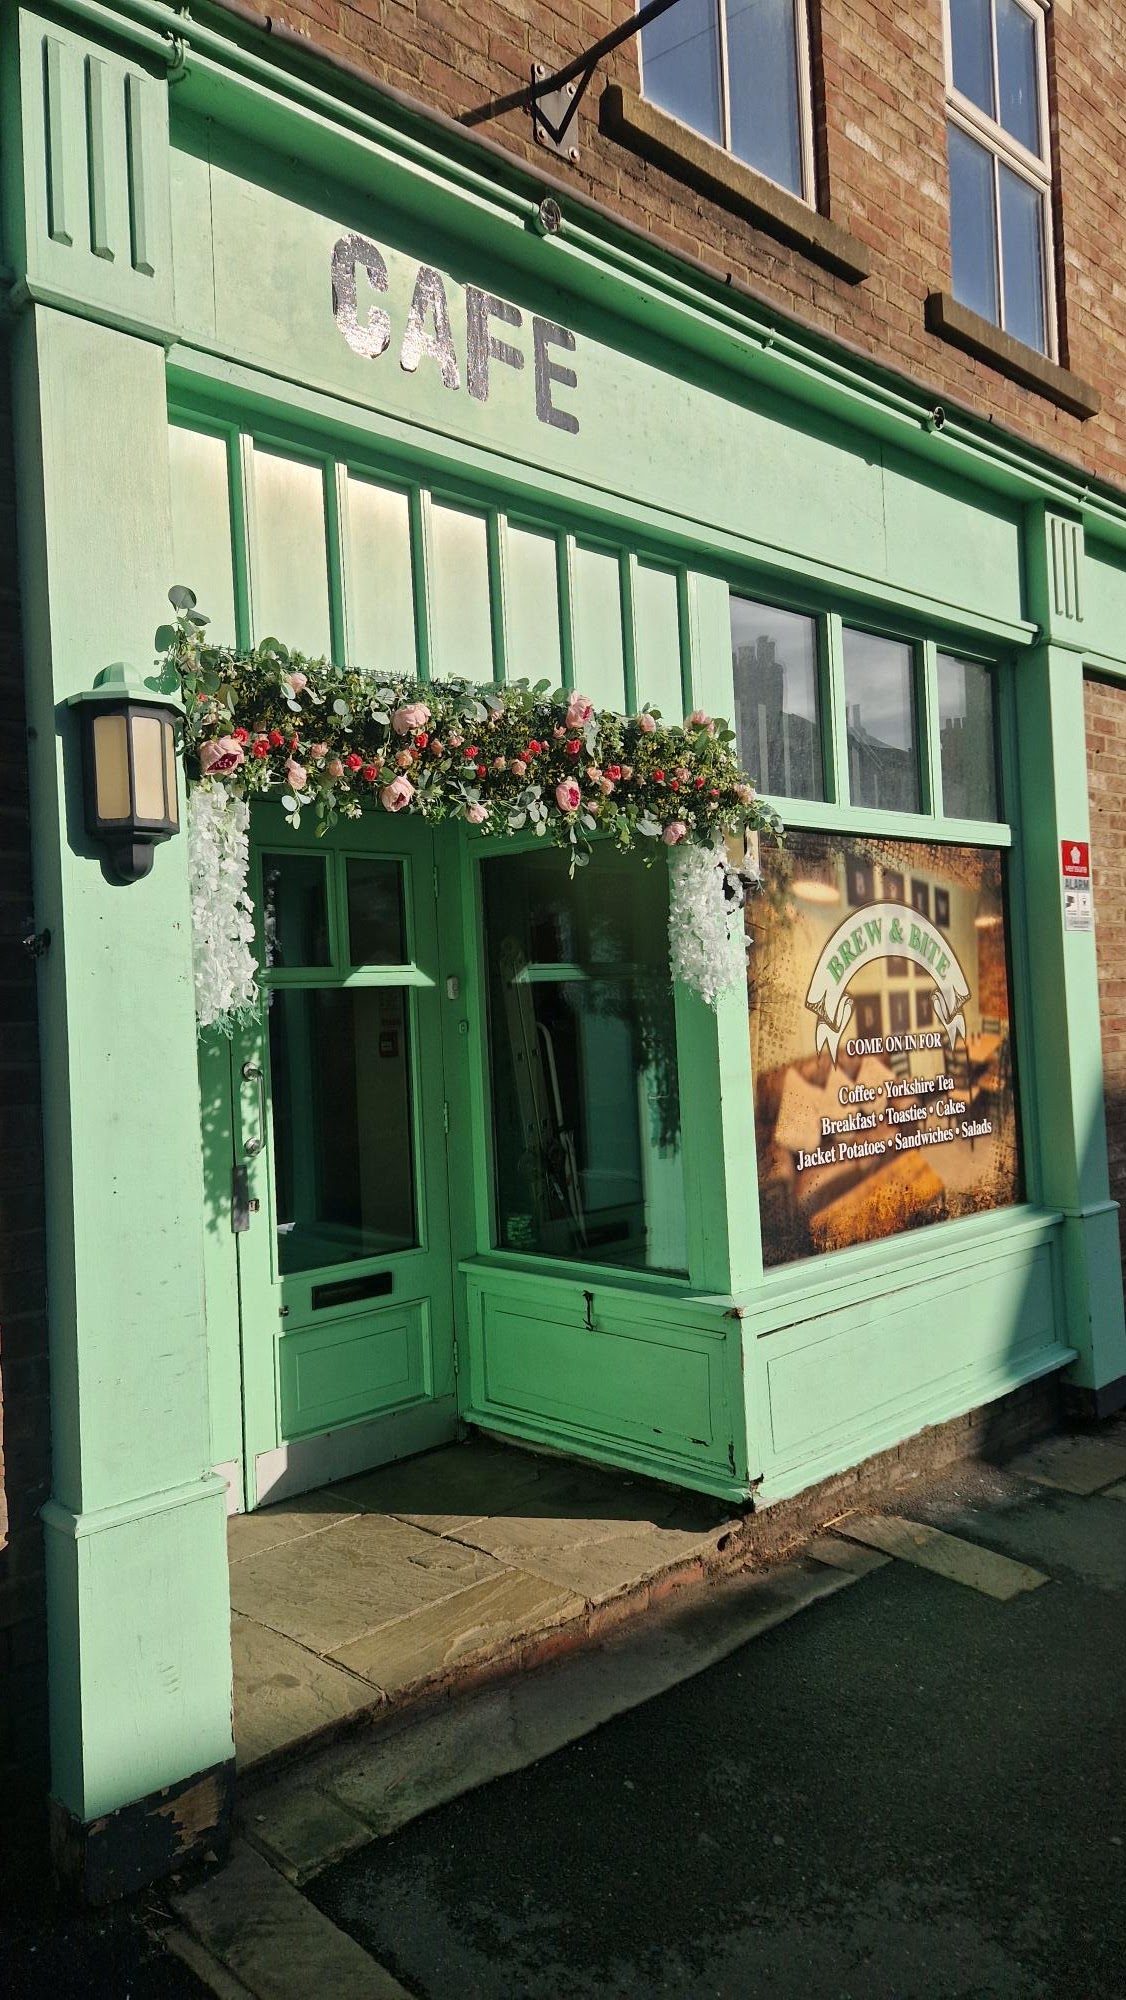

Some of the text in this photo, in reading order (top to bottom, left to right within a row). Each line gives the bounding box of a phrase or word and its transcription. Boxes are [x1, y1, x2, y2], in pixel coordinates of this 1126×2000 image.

[331, 233, 580, 435] CAFE
[826, 918, 951, 986] BREW & BITE
[846, 1033, 942, 1056] COME ON IN FOR
[838, 1074, 954, 1104] Coffee Yorkshire Tea
[821, 1100, 966, 1136] Breakfast Toasties Cakes
[797, 1119, 992, 1171] Jacket Potatoes Sandwiches Salads
